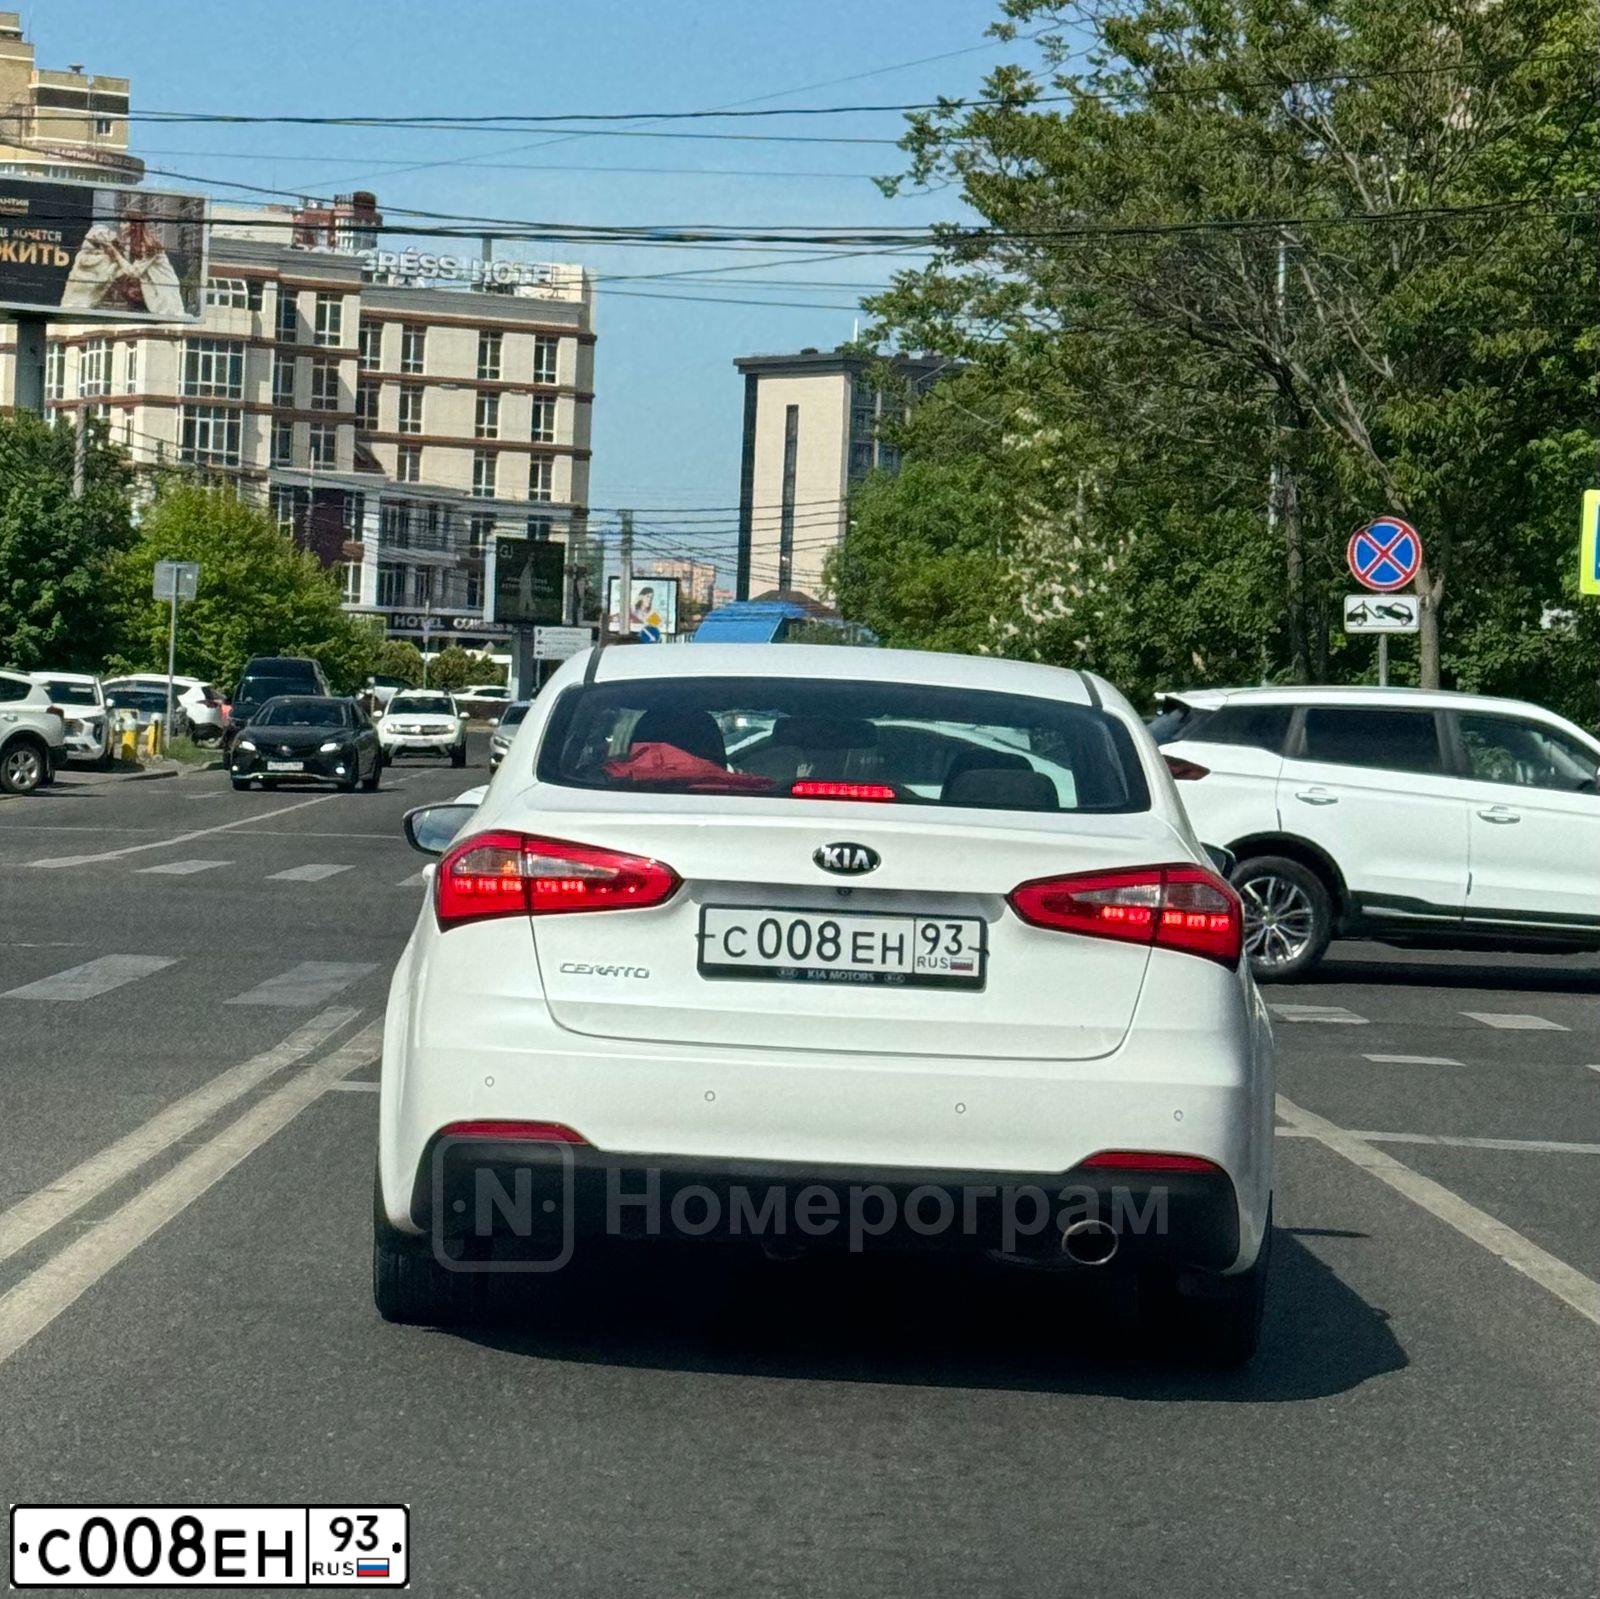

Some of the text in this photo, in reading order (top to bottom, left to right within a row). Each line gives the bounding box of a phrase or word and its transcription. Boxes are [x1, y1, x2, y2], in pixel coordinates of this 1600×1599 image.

[0, 240, 70, 267] ЖИТЬ
[822, 847, 870, 869] KIA
[921, 923, 963, 956] 93
[560, 963, 650, 979] CERATO
[917, 956, 949, 969] RUS
[807, 969, 827, 980] KIA
[829, 971, 875, 982] MOTORS
